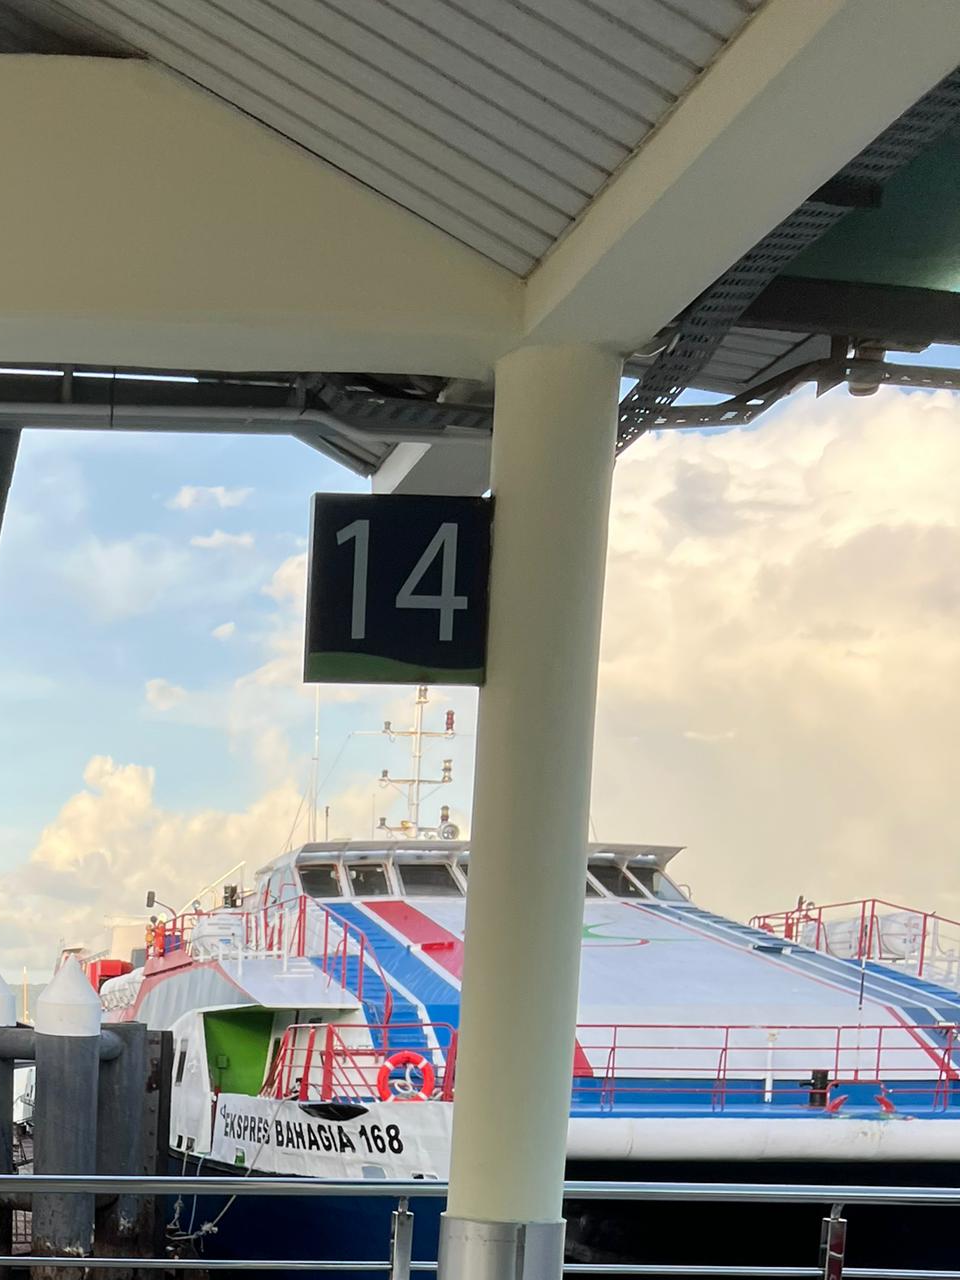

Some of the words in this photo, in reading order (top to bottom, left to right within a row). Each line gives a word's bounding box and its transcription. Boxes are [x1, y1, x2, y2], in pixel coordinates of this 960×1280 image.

[336, 519, 468, 641] 14
[224, 1112, 270, 1144] EKSPRES
[275, 1119, 356, 1153] BAHAGIA
[359, 1124, 404, 1154] 168
